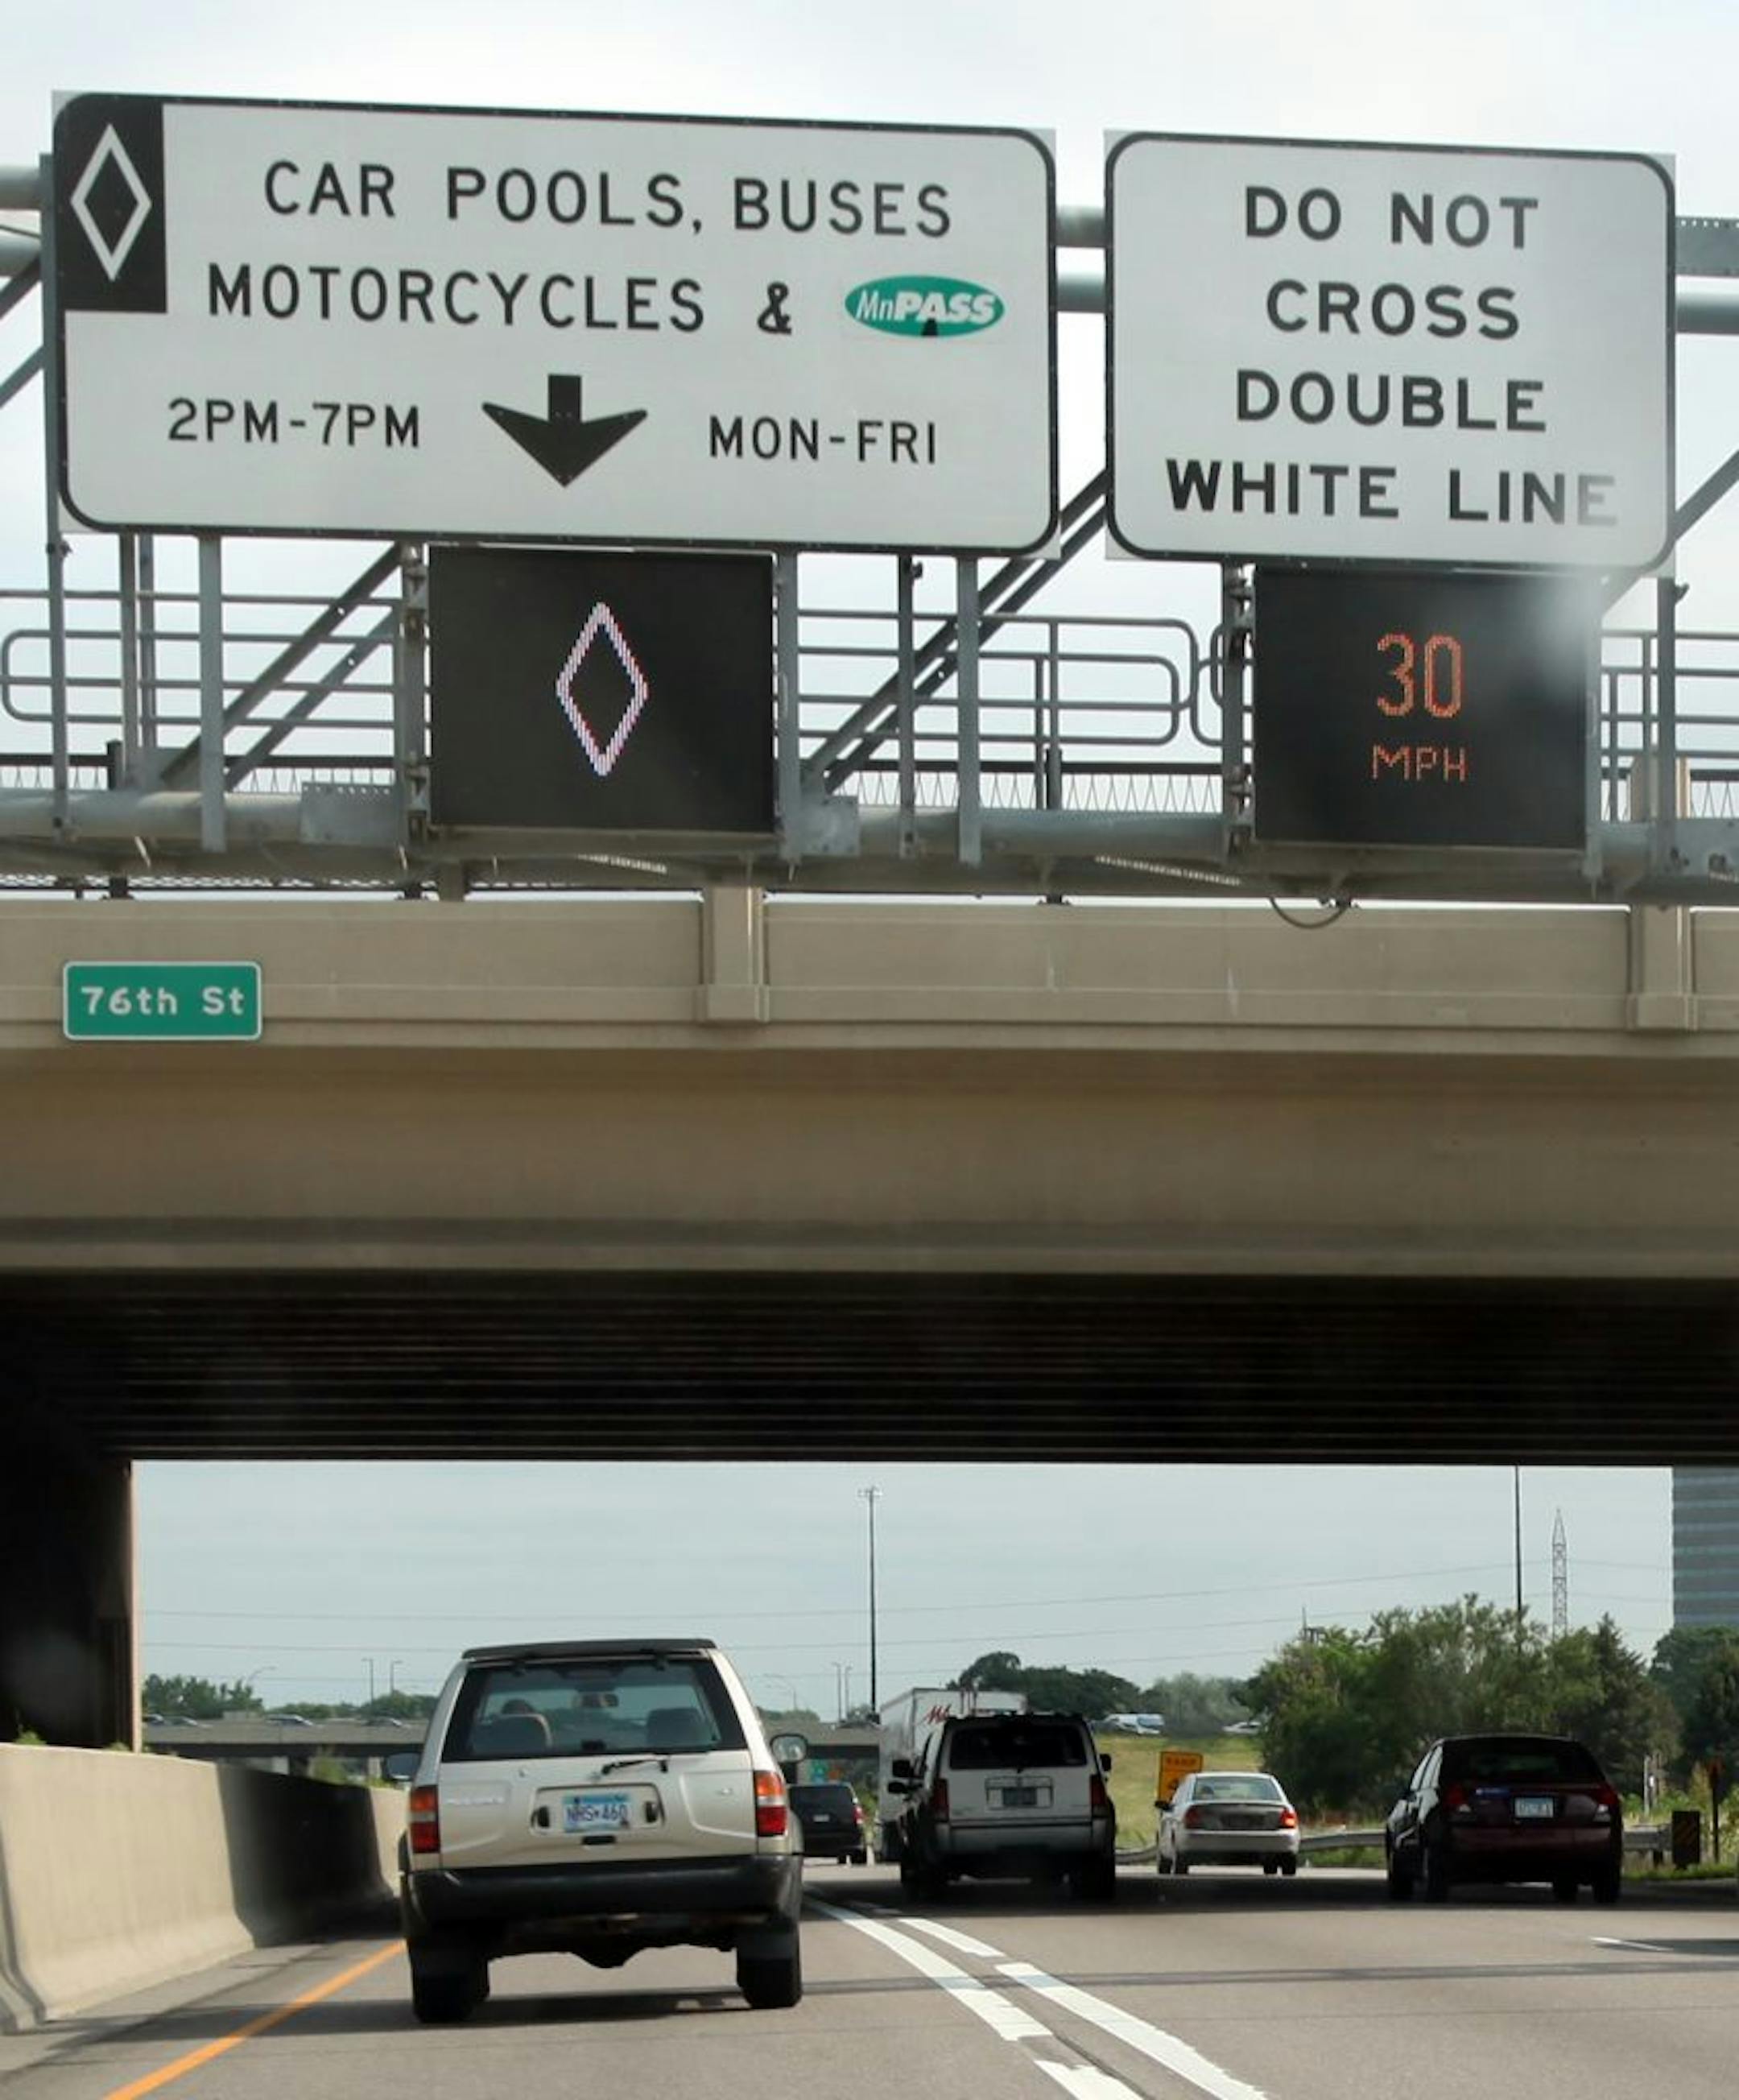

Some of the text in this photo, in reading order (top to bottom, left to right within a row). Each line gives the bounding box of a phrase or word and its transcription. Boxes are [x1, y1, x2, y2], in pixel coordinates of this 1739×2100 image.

[265, 160, 950, 238] CAR POOLS, BUSES
[1245, 186, 1539, 249] DO NOT
[209, 262, 996, 336] MOTORCYCLES & MnPASS
[1266, 279, 1519, 340] CROSS
[168, 397, 936, 465] 2PM-7PM MON-FRI
[1237, 369, 1546, 432] DOUBLE
[1166, 458, 1617, 527] WHITE LINE
[1375, 631, 1464, 719] 30
[1373, 745, 1468, 783] MPH
[81, 986, 245, 1015] 76th St
